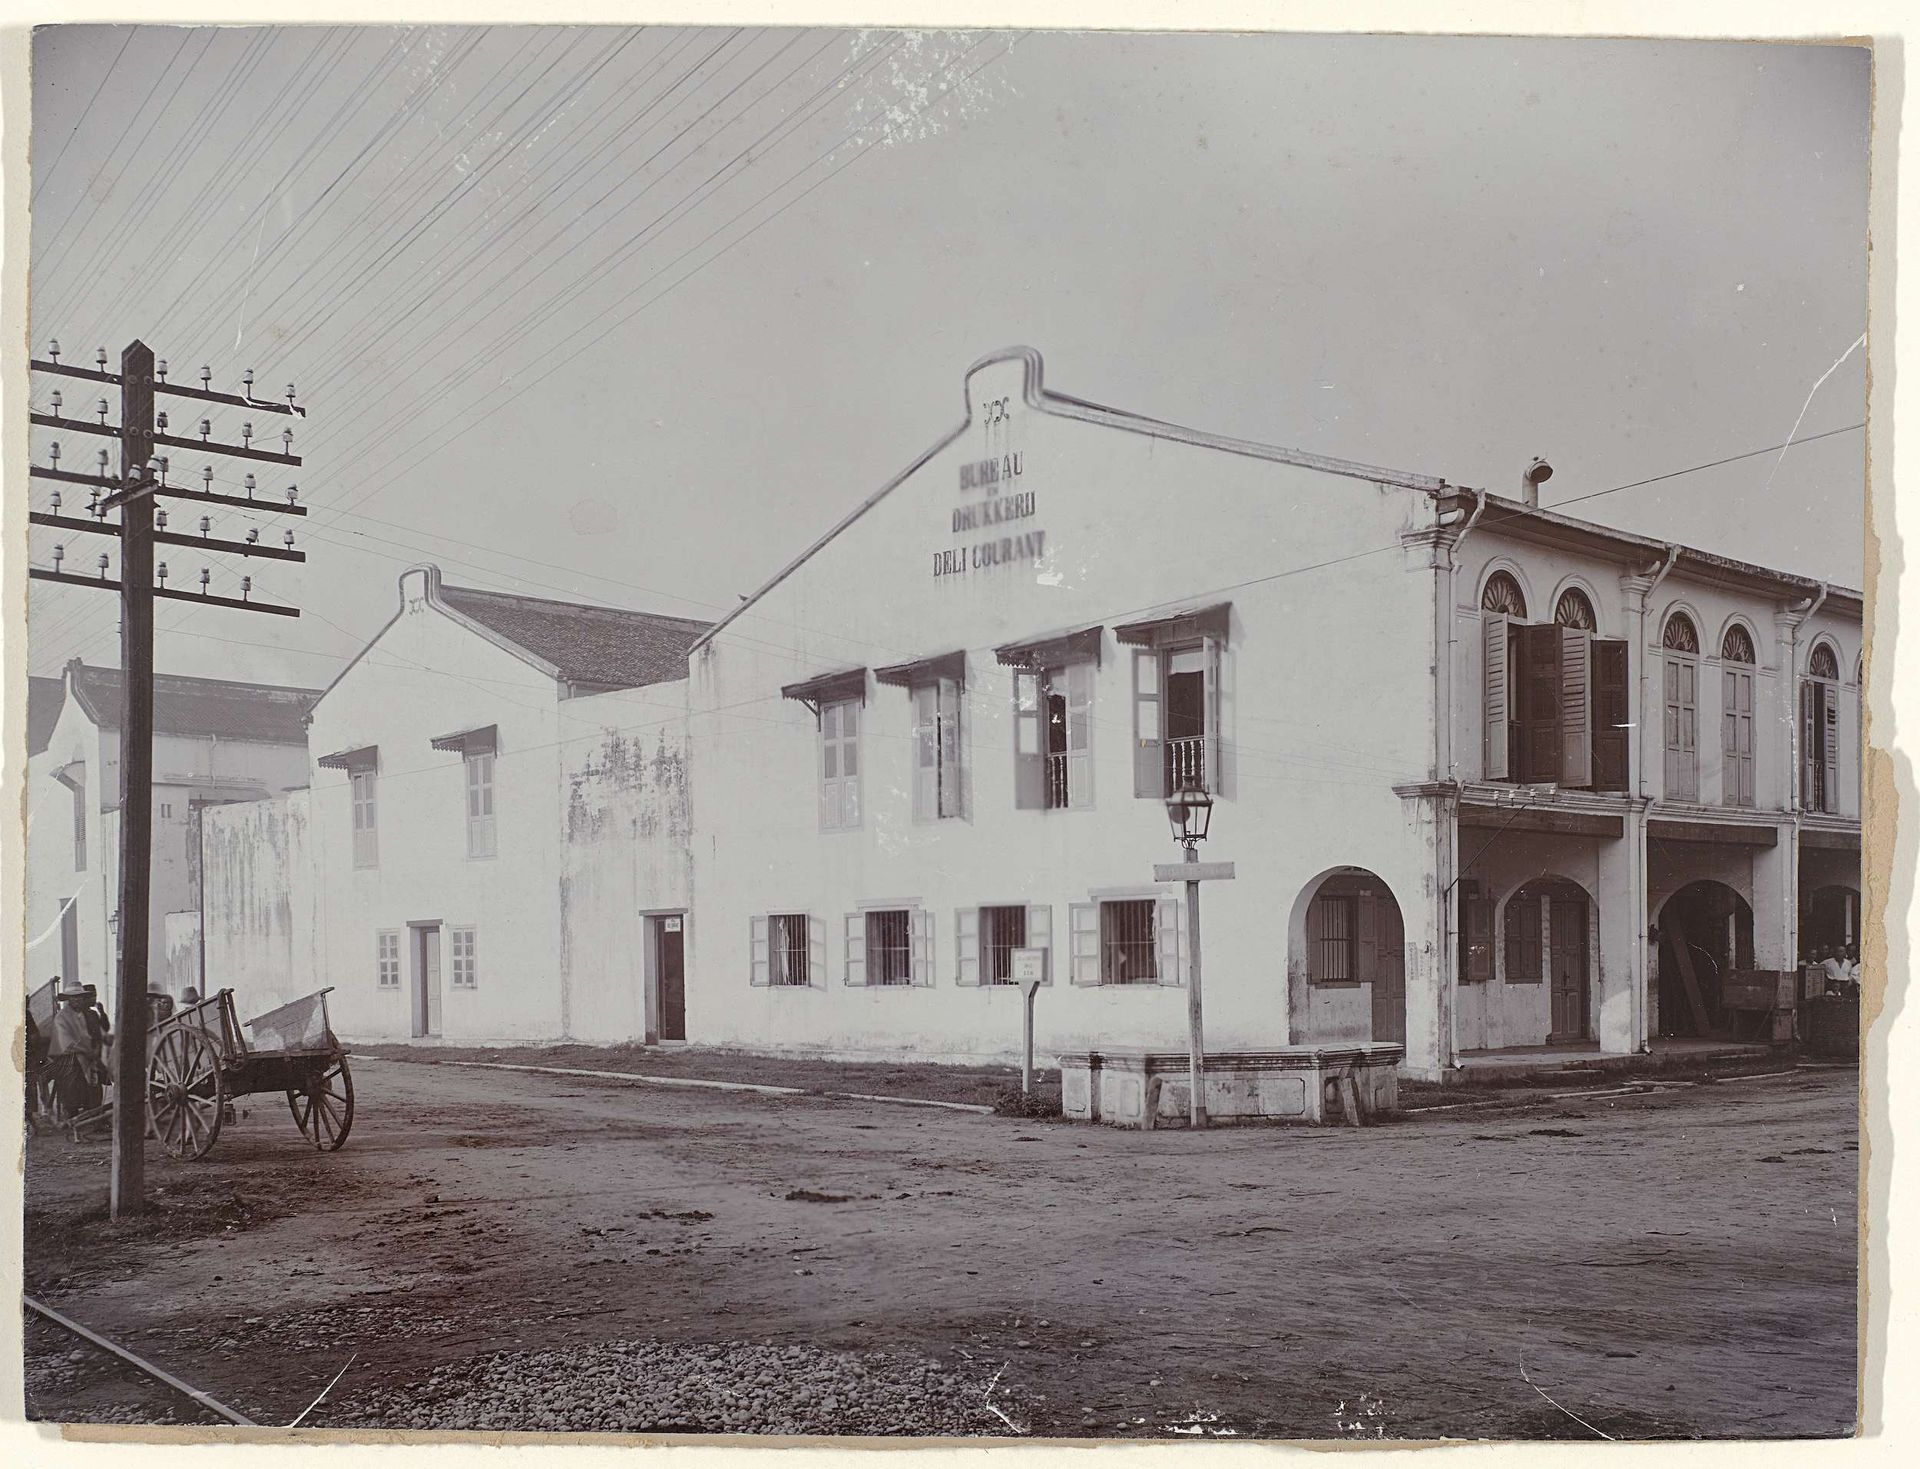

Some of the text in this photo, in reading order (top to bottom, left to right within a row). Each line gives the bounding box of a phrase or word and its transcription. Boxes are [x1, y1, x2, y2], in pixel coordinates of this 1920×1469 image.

[959, 451, 1023, 490] BUREAU
[952, 491, 1035, 533] DRUKKERIJ
[933, 530, 1045, 577] DELI COURANT
